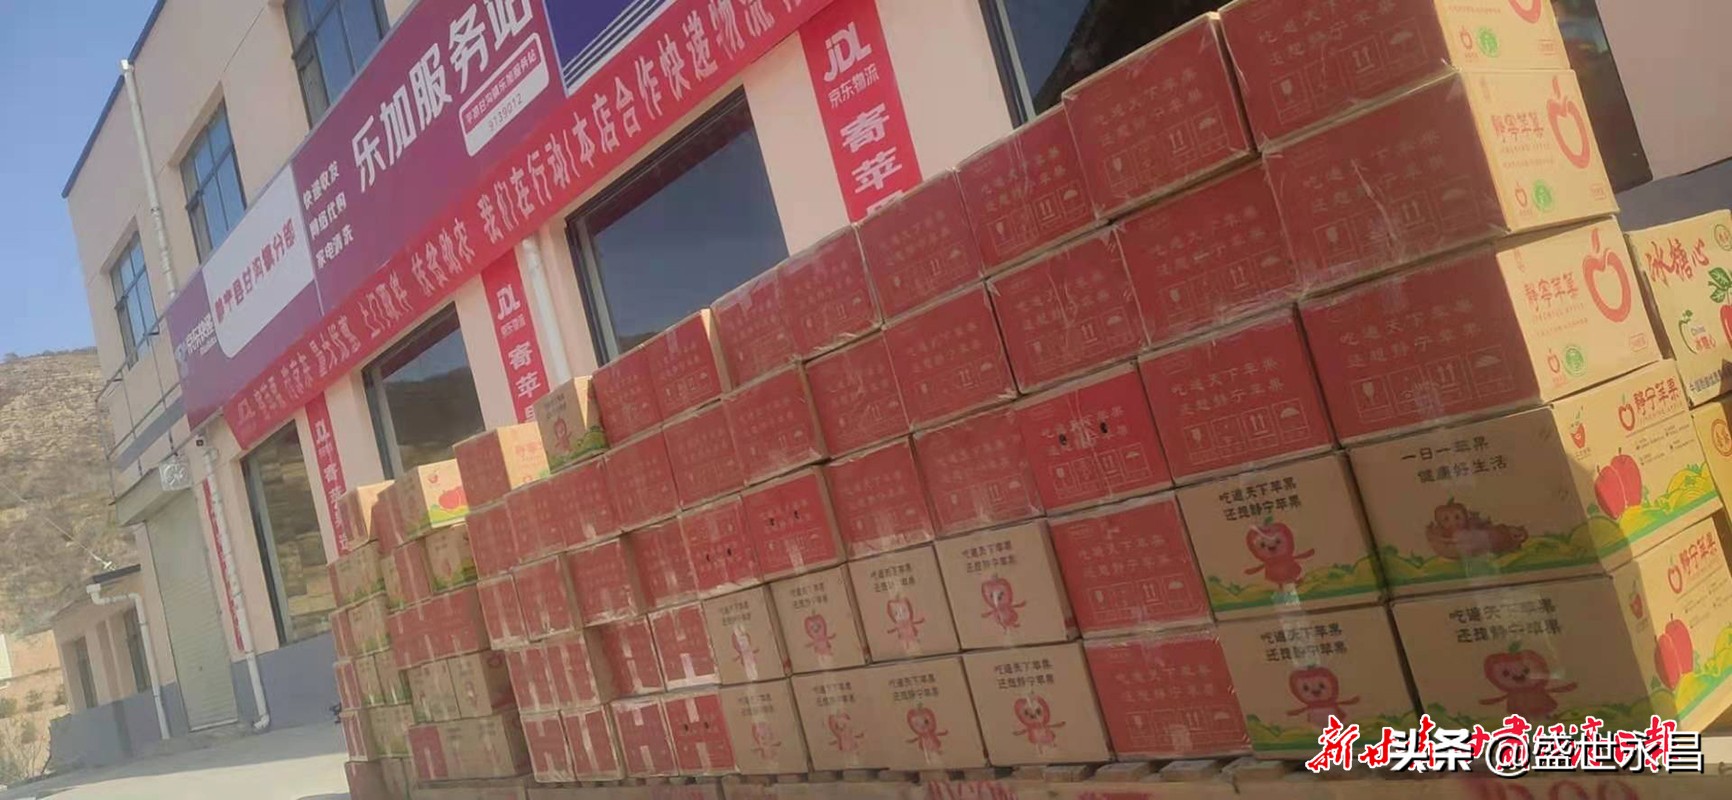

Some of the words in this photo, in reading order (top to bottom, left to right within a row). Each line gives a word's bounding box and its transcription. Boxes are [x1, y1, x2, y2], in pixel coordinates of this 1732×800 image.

[824, 21, 873, 82] JDL
[352, 0, 533, 192] 乐加服务站
[828, 63, 880, 109] 京东物流
[488, 93, 523, 131] 9139012
[303, 161, 340, 210] 快递收发
[309, 191, 347, 240] 网络代购
[315, 224, 354, 270] 家电清洗
[411, 217, 476, 298] 扶贫助农
[1645, 237, 1710, 287] 冰糖心
[1633, 377, 1680, 415] 静宁苹果
[1401, 436, 1491, 461] 一日一苹果
[1417, 454, 1507, 484] 健康好生活
[1219, 477, 1297, 505] 吃遍天下苹果
[1223, 494, 1302, 522] 还想静宁苹果
[1449, 597, 1557, 624] 吃遍天下苹果
[1261, 622, 1342, 643] 吃遍天下苹果
